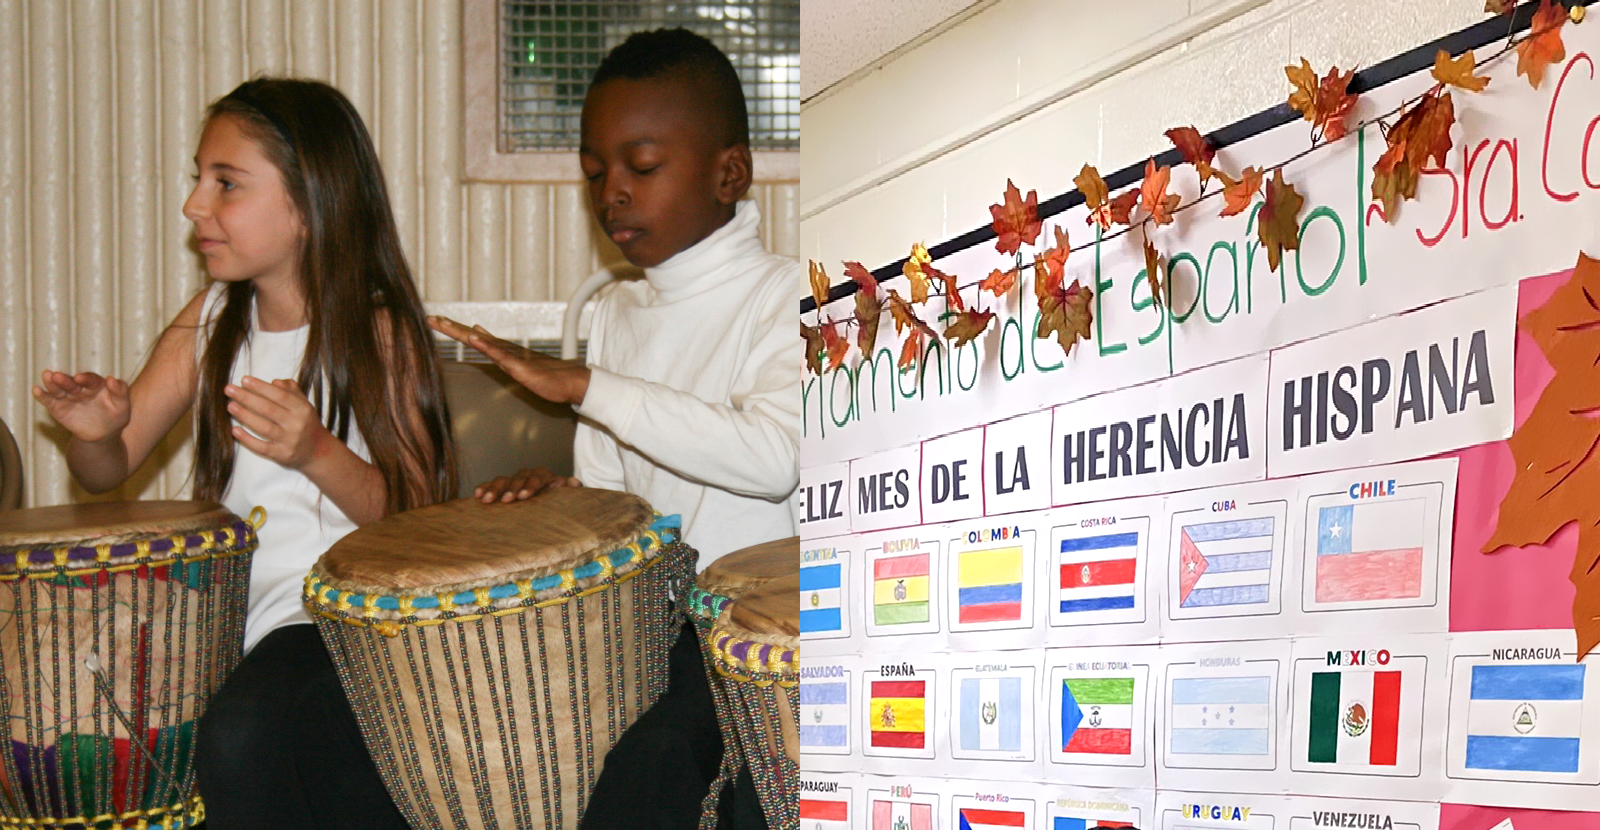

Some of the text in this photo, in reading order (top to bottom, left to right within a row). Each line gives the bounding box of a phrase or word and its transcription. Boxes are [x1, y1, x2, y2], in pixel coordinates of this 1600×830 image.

[858, 468, 909, 515] MES
[931, 459, 970, 504] DE
[995, 445, 1031, 495] LA
[1064, 393, 1249, 485] HERENCIA
[1283, 329, 1495, 452] HISPANA
[1349, 479, 1396, 500] CHILE
[1211, 499, 1237, 513] CUBA
[1081, 516, 1116, 528] COSTA RICA
[962, 525, 1021, 544] COLOMBIA
[882, 538, 920, 554] BOLIVIA
[1326, 649, 1390, 667] MEXICO
[1492, 647, 1561, 661] NICARAGUA
[880, 661, 915, 677] ESPAÑA
[1068, 661, 1131, 671] GINE ECUTORIA
[1199, 657, 1241, 668] HONDURAS
[800, 664, 844, 678] SALVADOR
[800, 781, 838, 793] PARAGUAY
[890, 783, 913, 798] PERÚ
[975, 792, 995, 803] Puerto
[1182, 804, 1251, 821] URUGUAY
[1312, 811, 1393, 830] VENEZUELA
